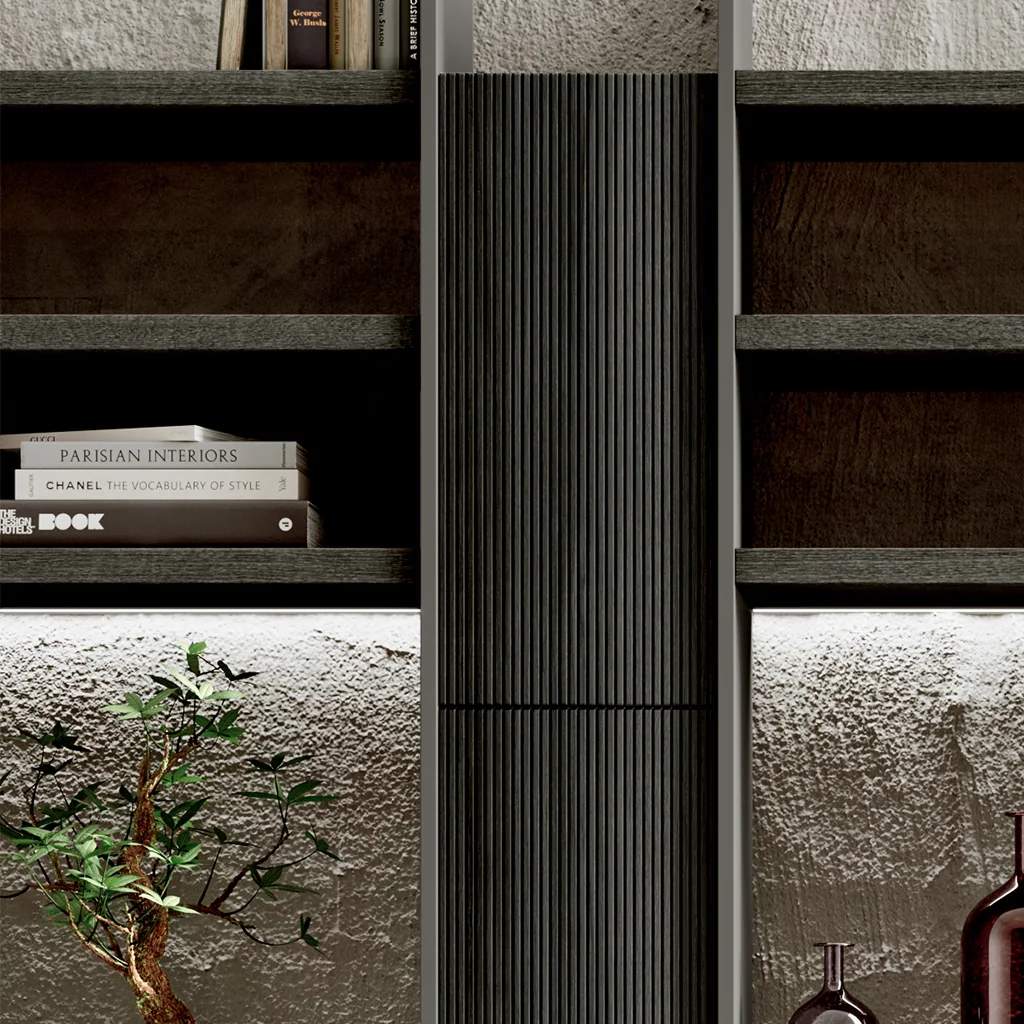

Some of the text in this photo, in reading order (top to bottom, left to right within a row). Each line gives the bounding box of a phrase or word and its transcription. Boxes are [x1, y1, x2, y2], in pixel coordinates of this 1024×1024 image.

[293, 9, 322, 17] George
[378, 20, 386, 46] SEASON
[60, 449, 238, 462] PARISIAN INTERIORS
[46, 481, 260, 490] CHANEL THE VOCABULARY OF STYLE
[278, 476, 286, 492] Yale
[0, 509, 16, 518] THE
[0, 517, 32, 526] DESIGN
[38, 513, 104, 530] BOOK
